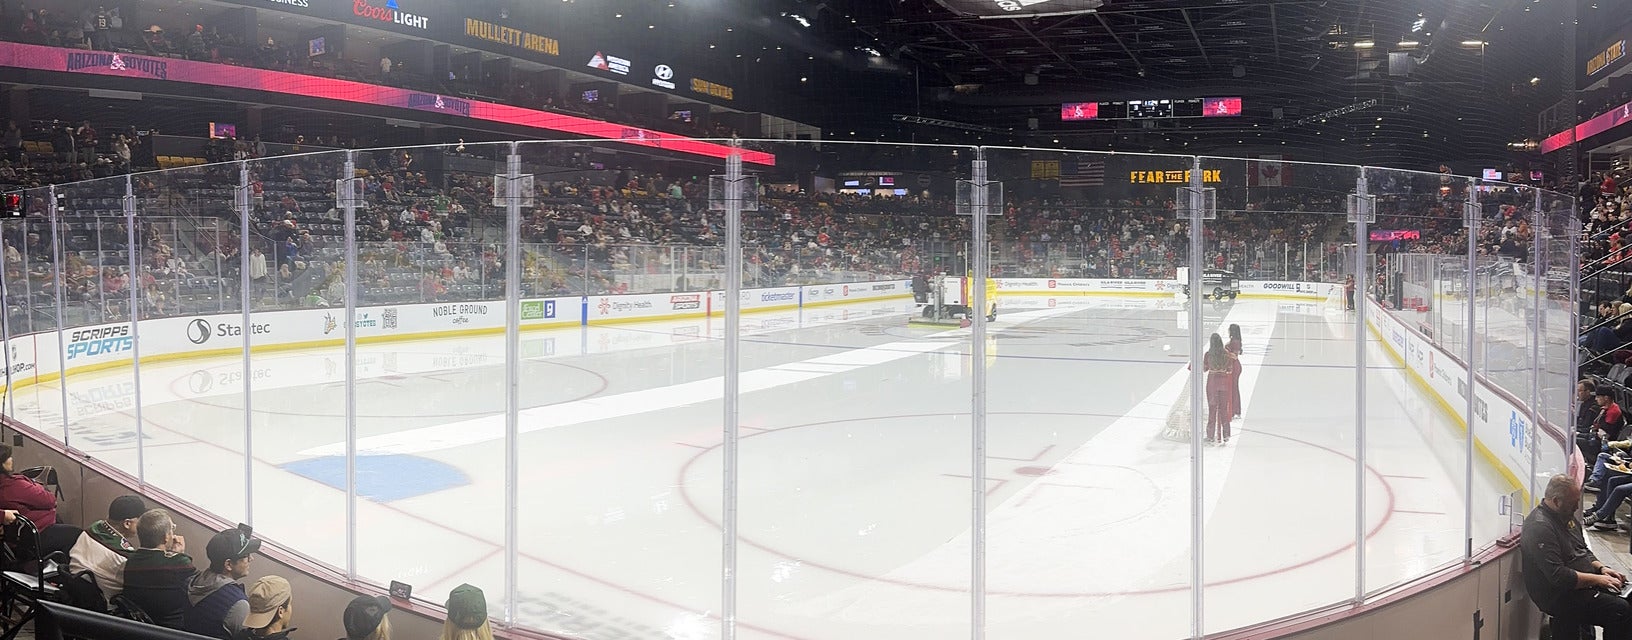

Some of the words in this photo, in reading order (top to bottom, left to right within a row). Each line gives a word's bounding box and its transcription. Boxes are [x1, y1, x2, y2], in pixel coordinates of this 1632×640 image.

[353, 0, 393, 22] Coors
[394, 11, 429, 30] LIGHT
[464, 18, 521, 46] MULLETT
[522, 32, 559, 56] ARENA
[67, 53, 113, 71] ARIZONA
[121, 56, 167, 80] COYOTES
[1130, 170, 1164, 183] FEAR
[1184, 170, 1221, 183] FRK
[433, 305, 457, 317] NOBLE
[460, 304, 488, 315] GROUND
[613, 301, 632, 311] Dignity
[72, 326, 128, 342] SCRIPPS
[217, 322, 271, 337] Statec
[67, 336, 133, 360] SPORTS
